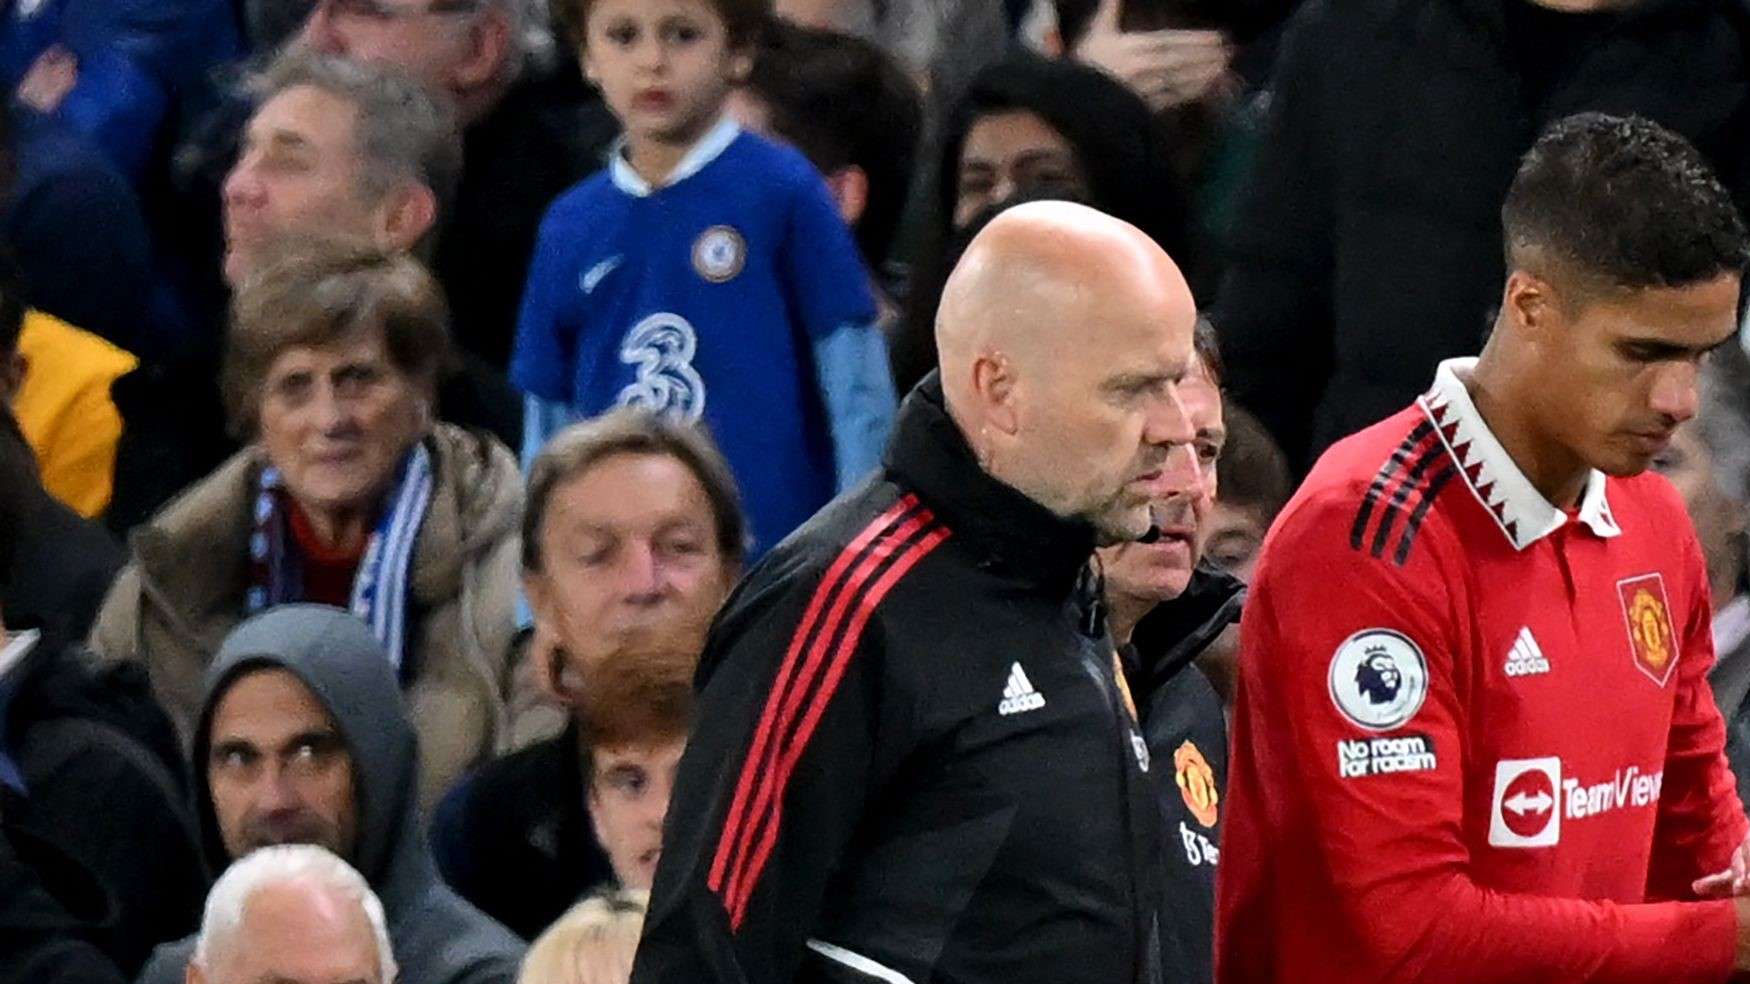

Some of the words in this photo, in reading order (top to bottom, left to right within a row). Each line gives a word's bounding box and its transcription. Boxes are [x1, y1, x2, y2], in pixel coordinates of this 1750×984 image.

[1504, 658, 1551, 678] adidas
[1337, 739, 1369, 761] No
[1370, 736, 1425, 758] room
[1371, 753, 1437, 774] racism
